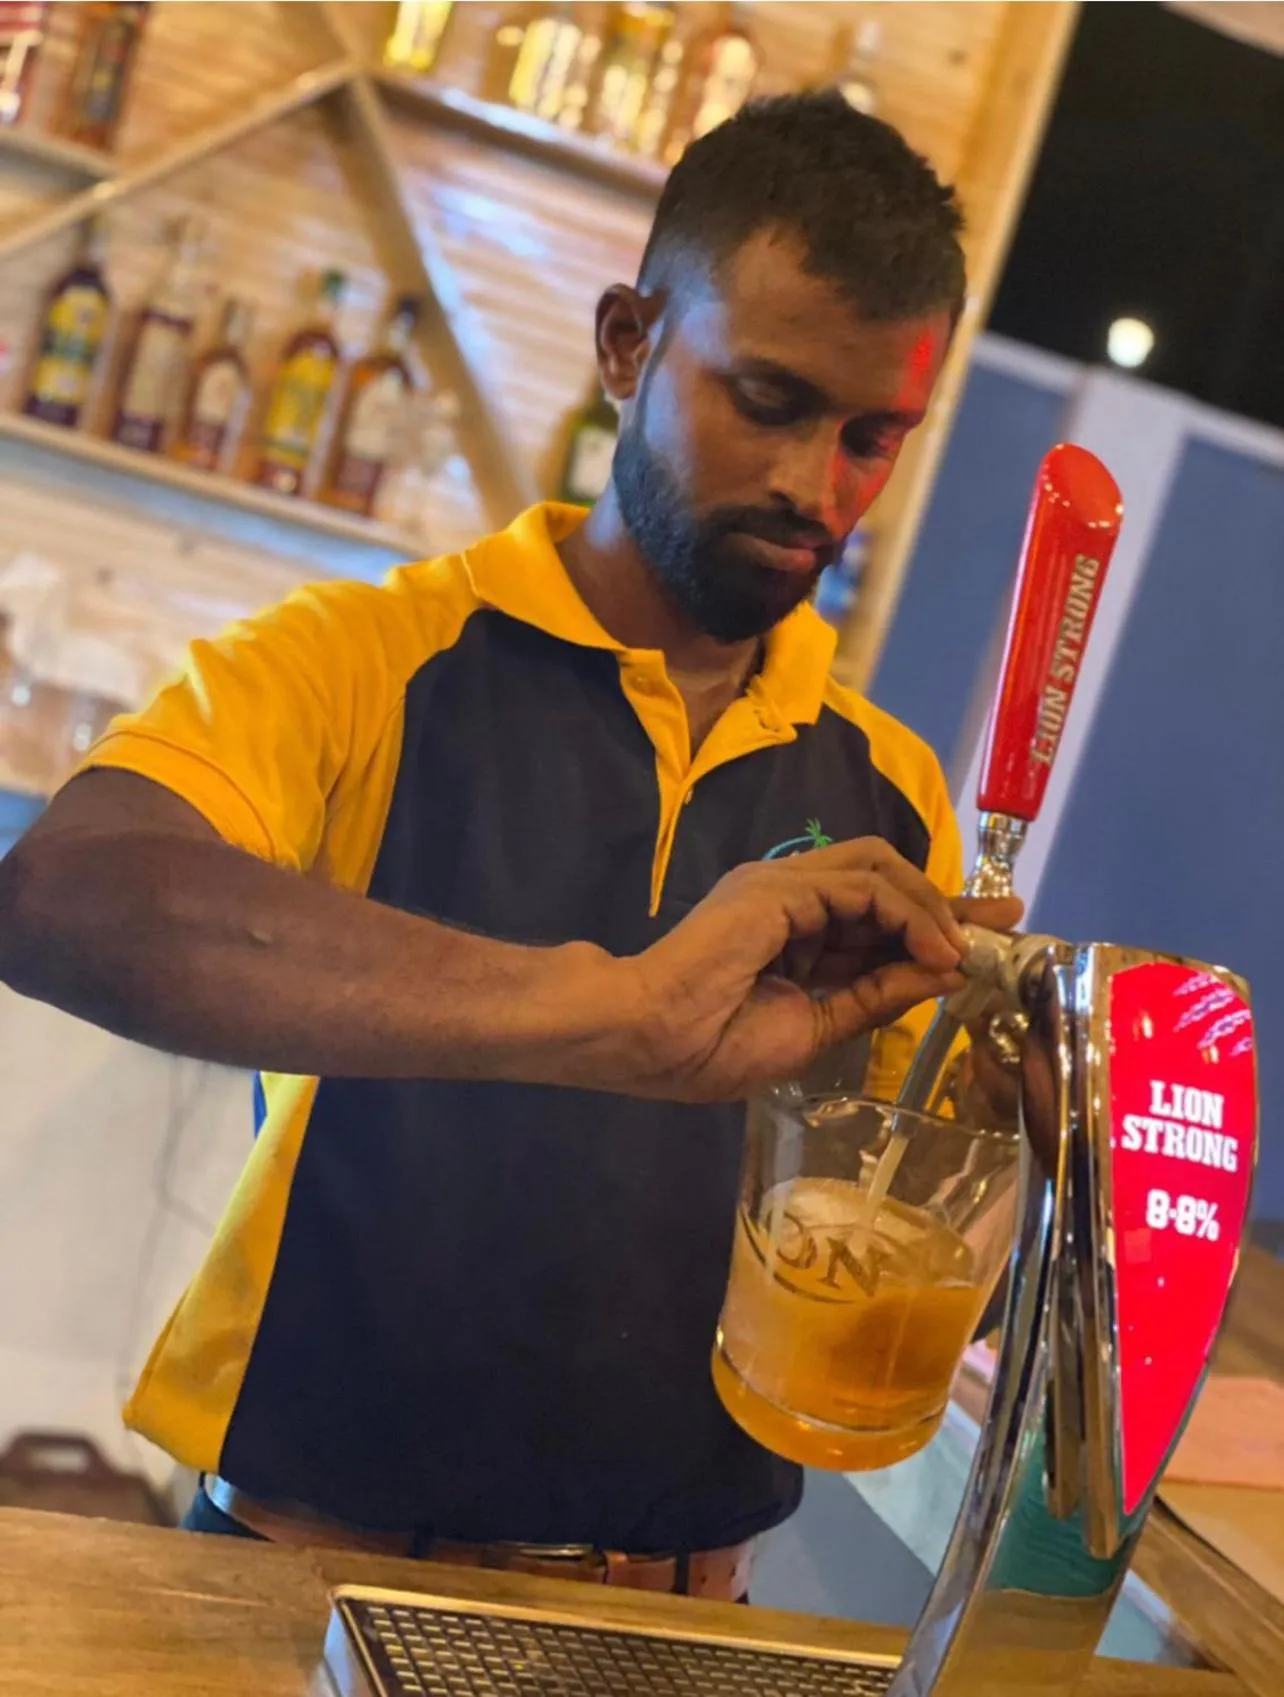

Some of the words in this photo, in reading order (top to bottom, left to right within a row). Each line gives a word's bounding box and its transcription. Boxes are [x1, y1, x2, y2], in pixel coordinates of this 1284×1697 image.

[1031, 684, 1068, 765] LION
[1051, 553, 1100, 684] STRONG
[1149, 1079, 1224, 1129] LION
[1121, 1113, 1239, 1173] STRONG
